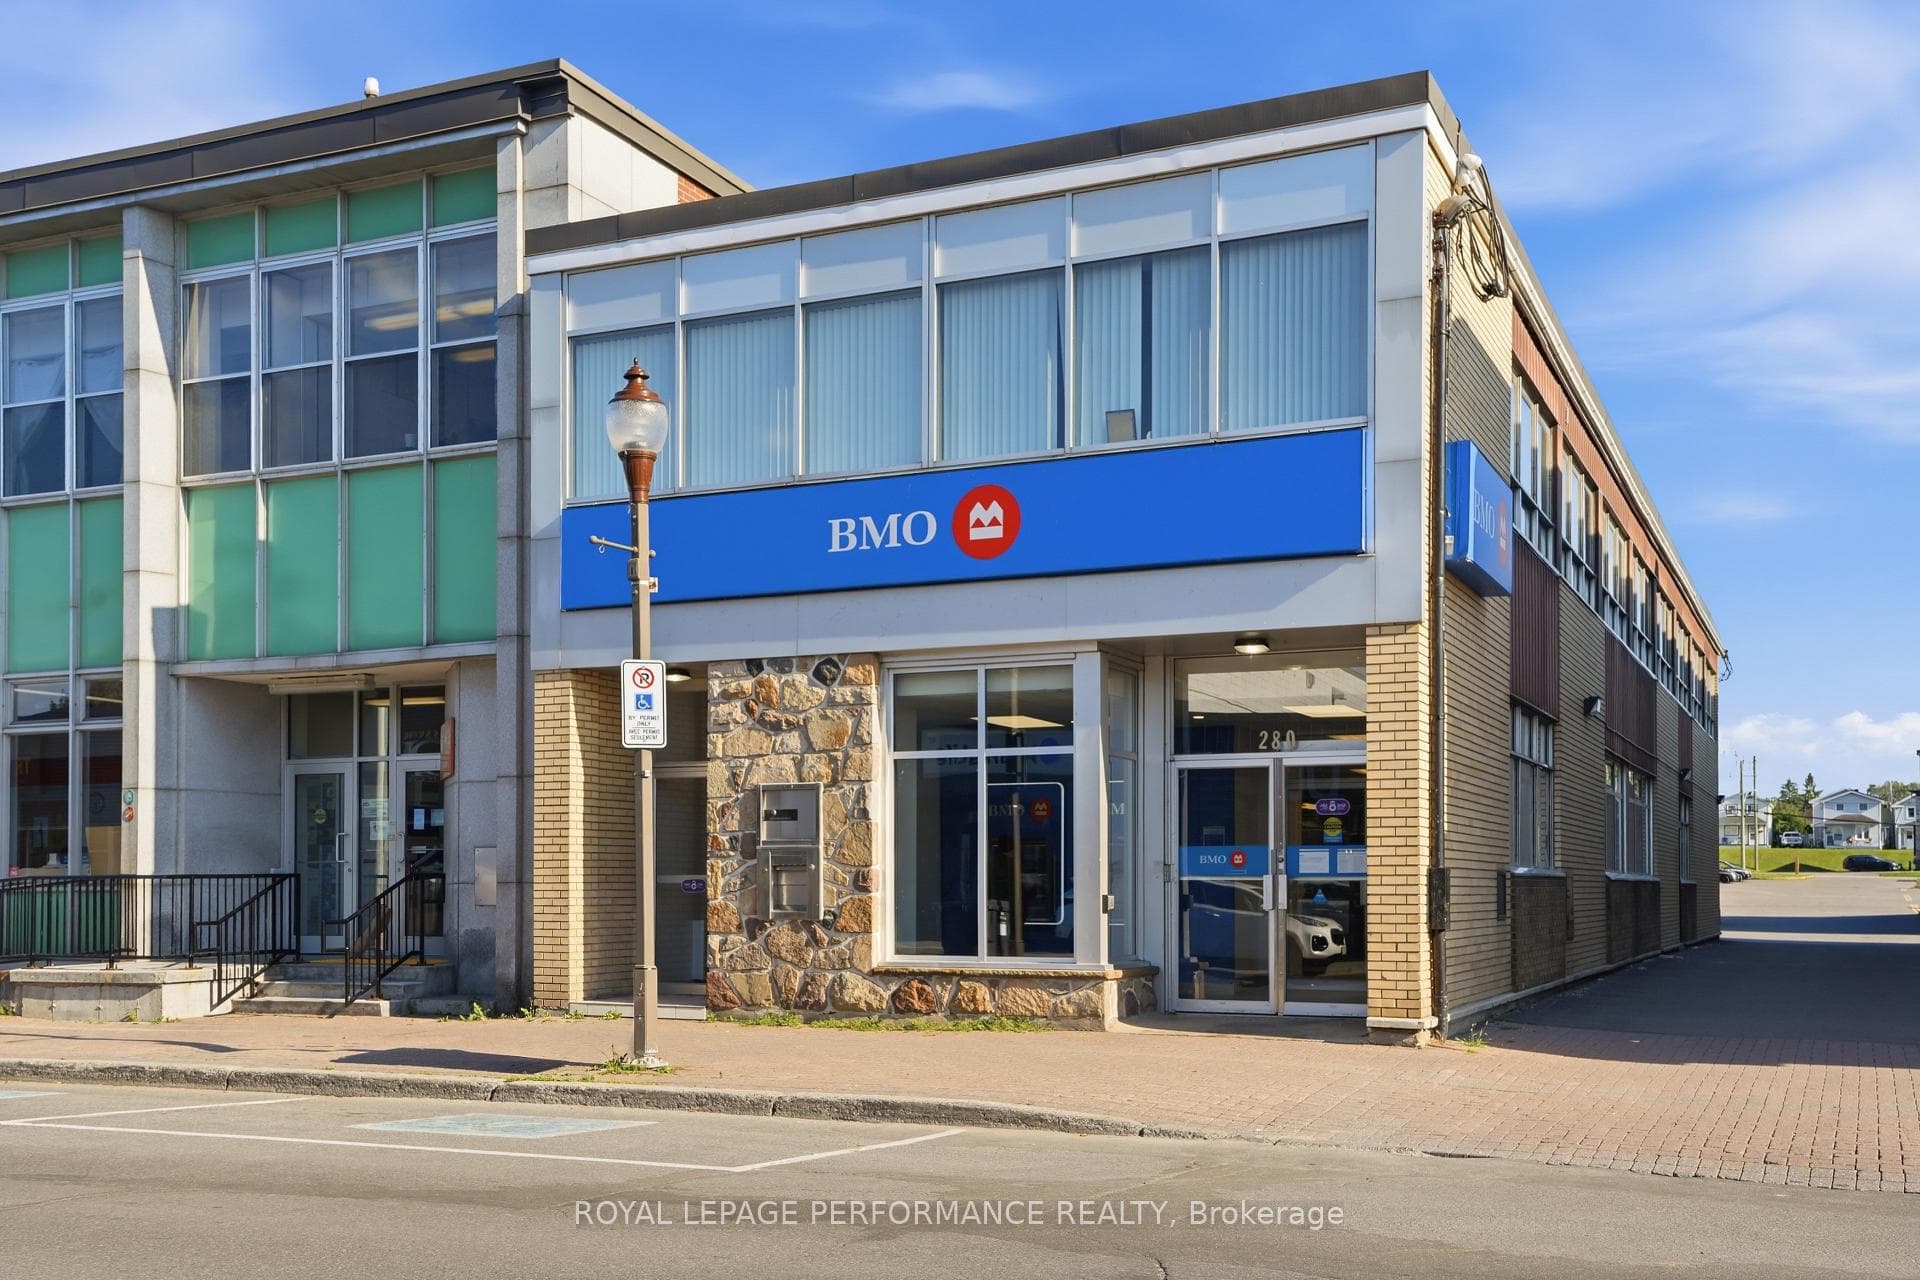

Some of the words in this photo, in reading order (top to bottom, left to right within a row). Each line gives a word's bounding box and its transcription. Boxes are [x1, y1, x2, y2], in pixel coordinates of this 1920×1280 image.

[1473, 489, 1496, 538] BMO
[827, 510, 938, 554] BMO
[1258, 729, 1297, 751] 280
[1199, 854, 1227, 864] BMO
